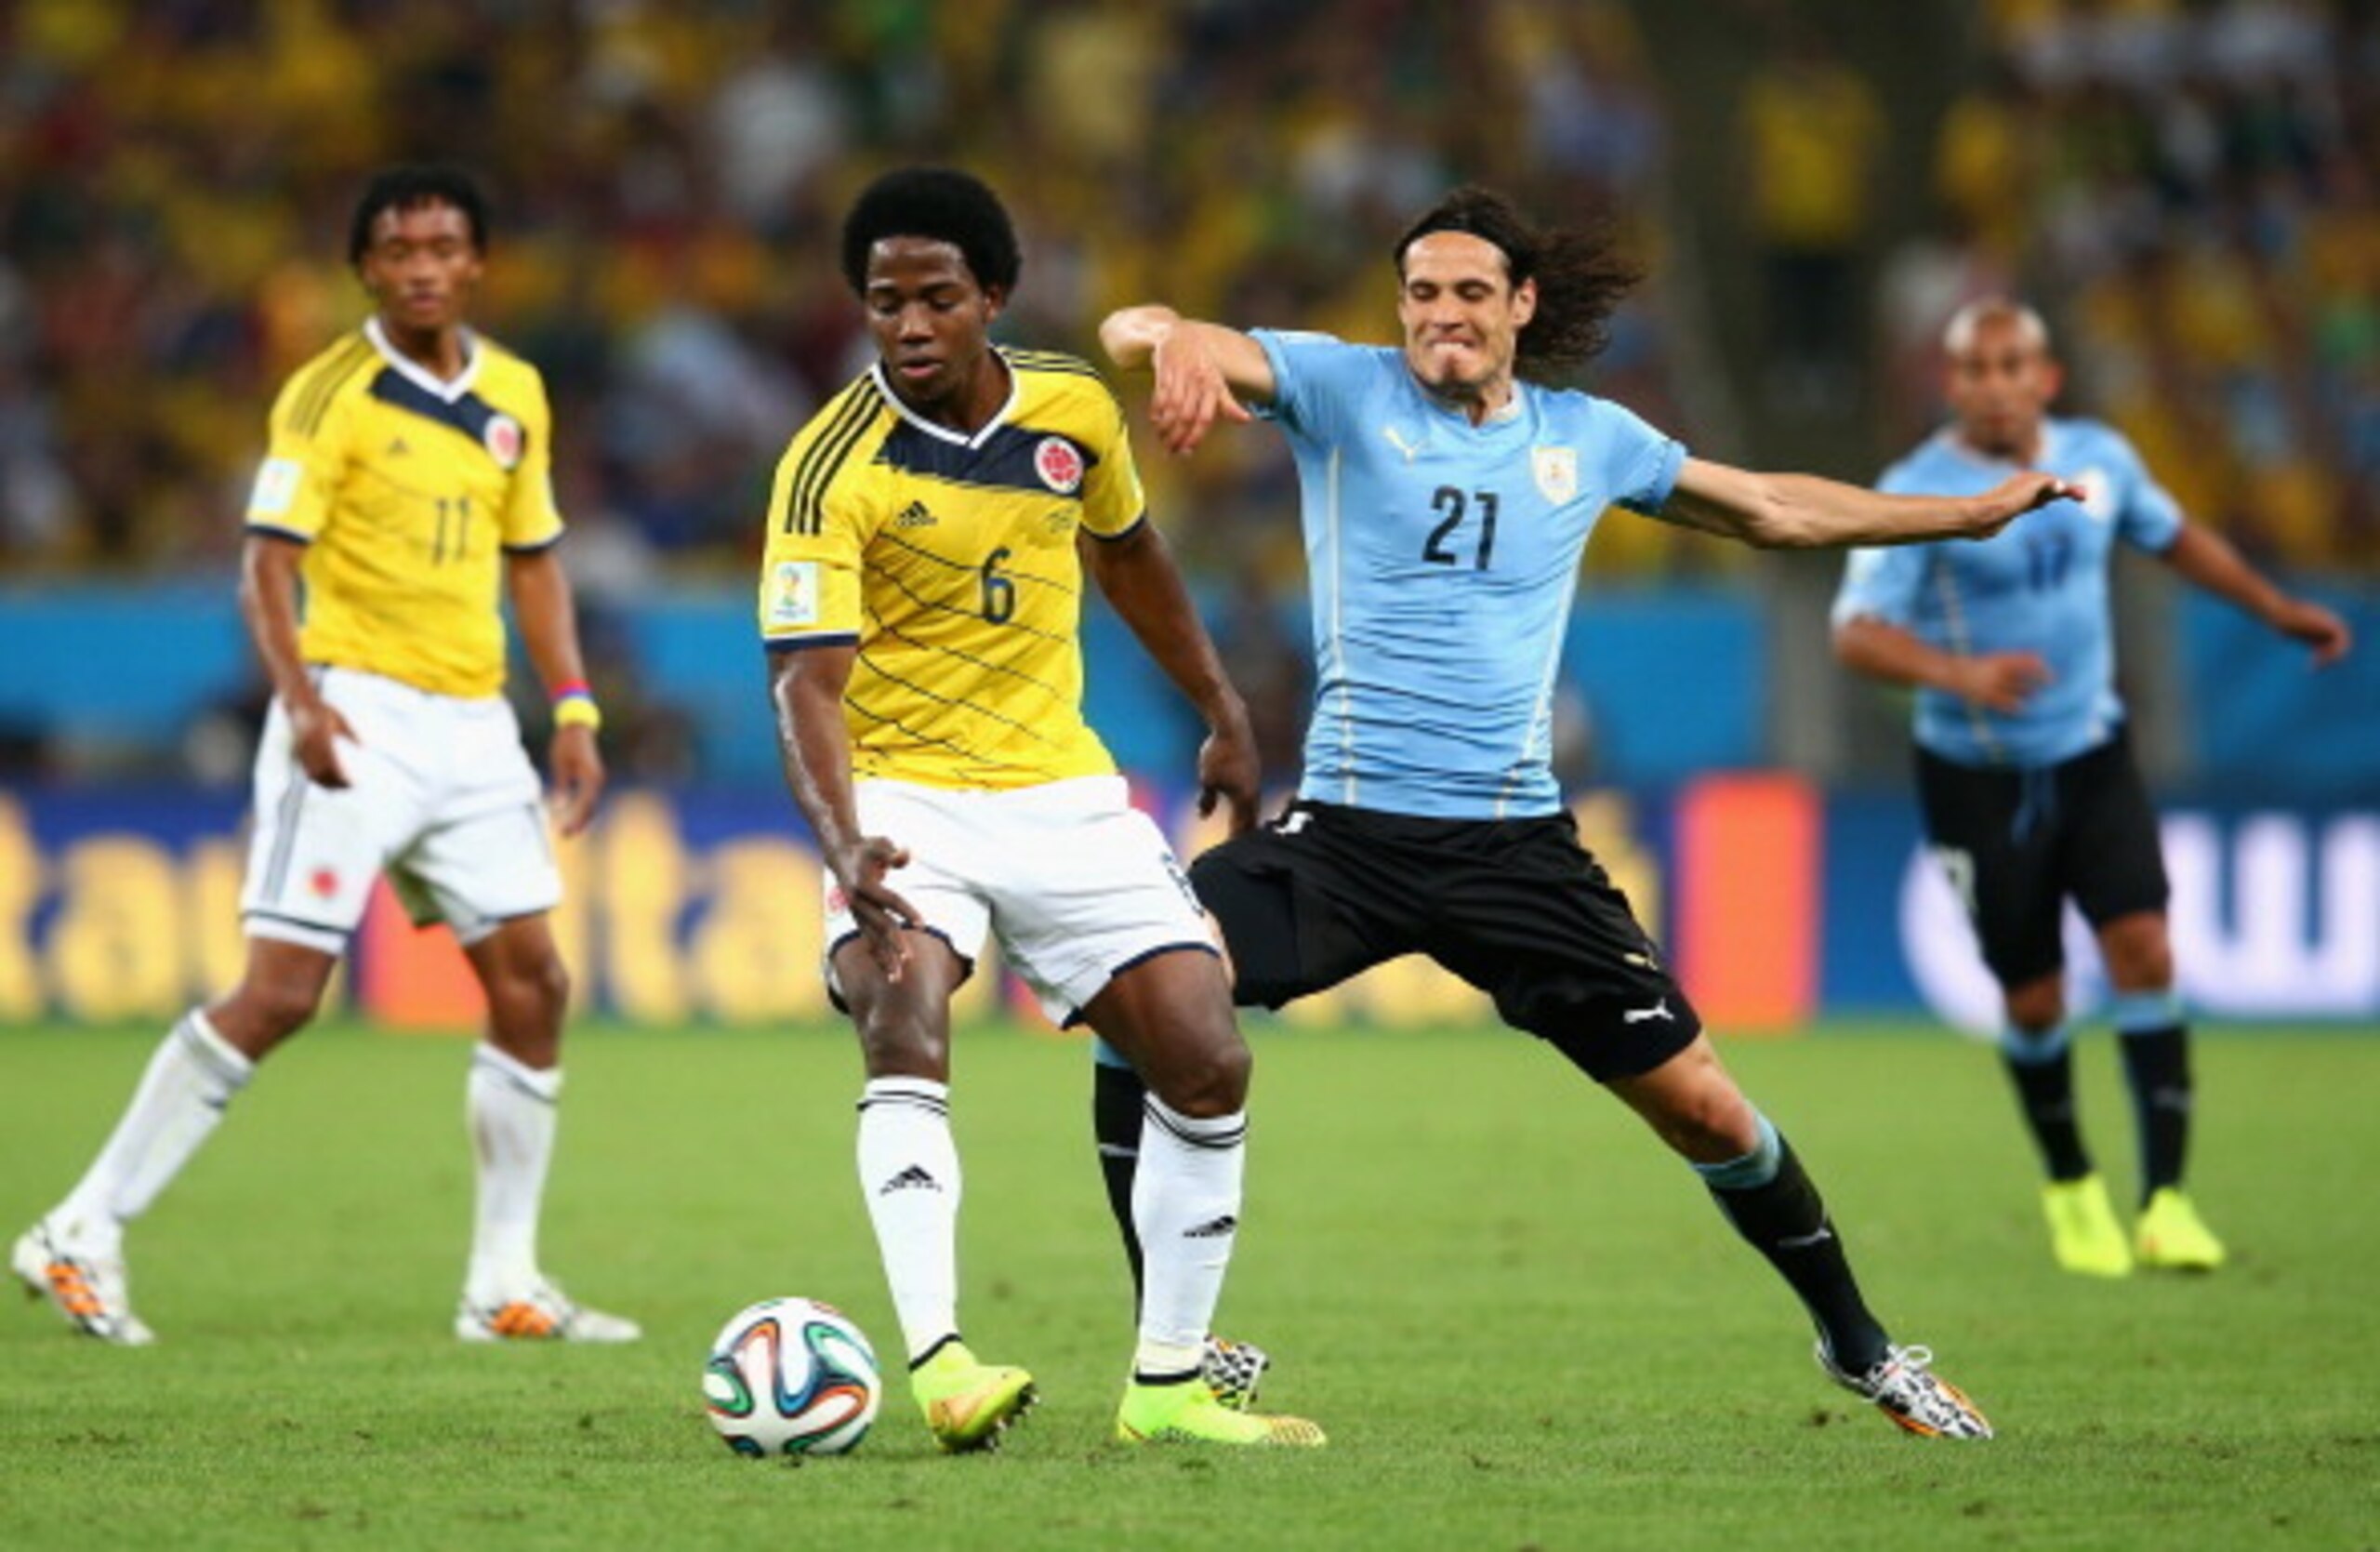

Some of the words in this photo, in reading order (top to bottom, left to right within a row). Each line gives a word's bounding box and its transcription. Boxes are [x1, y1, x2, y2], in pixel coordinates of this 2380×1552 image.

[432, 496, 470, 566] 11
[1421, 484, 1500, 572] 21
[980, 546, 1017, 625] 6
